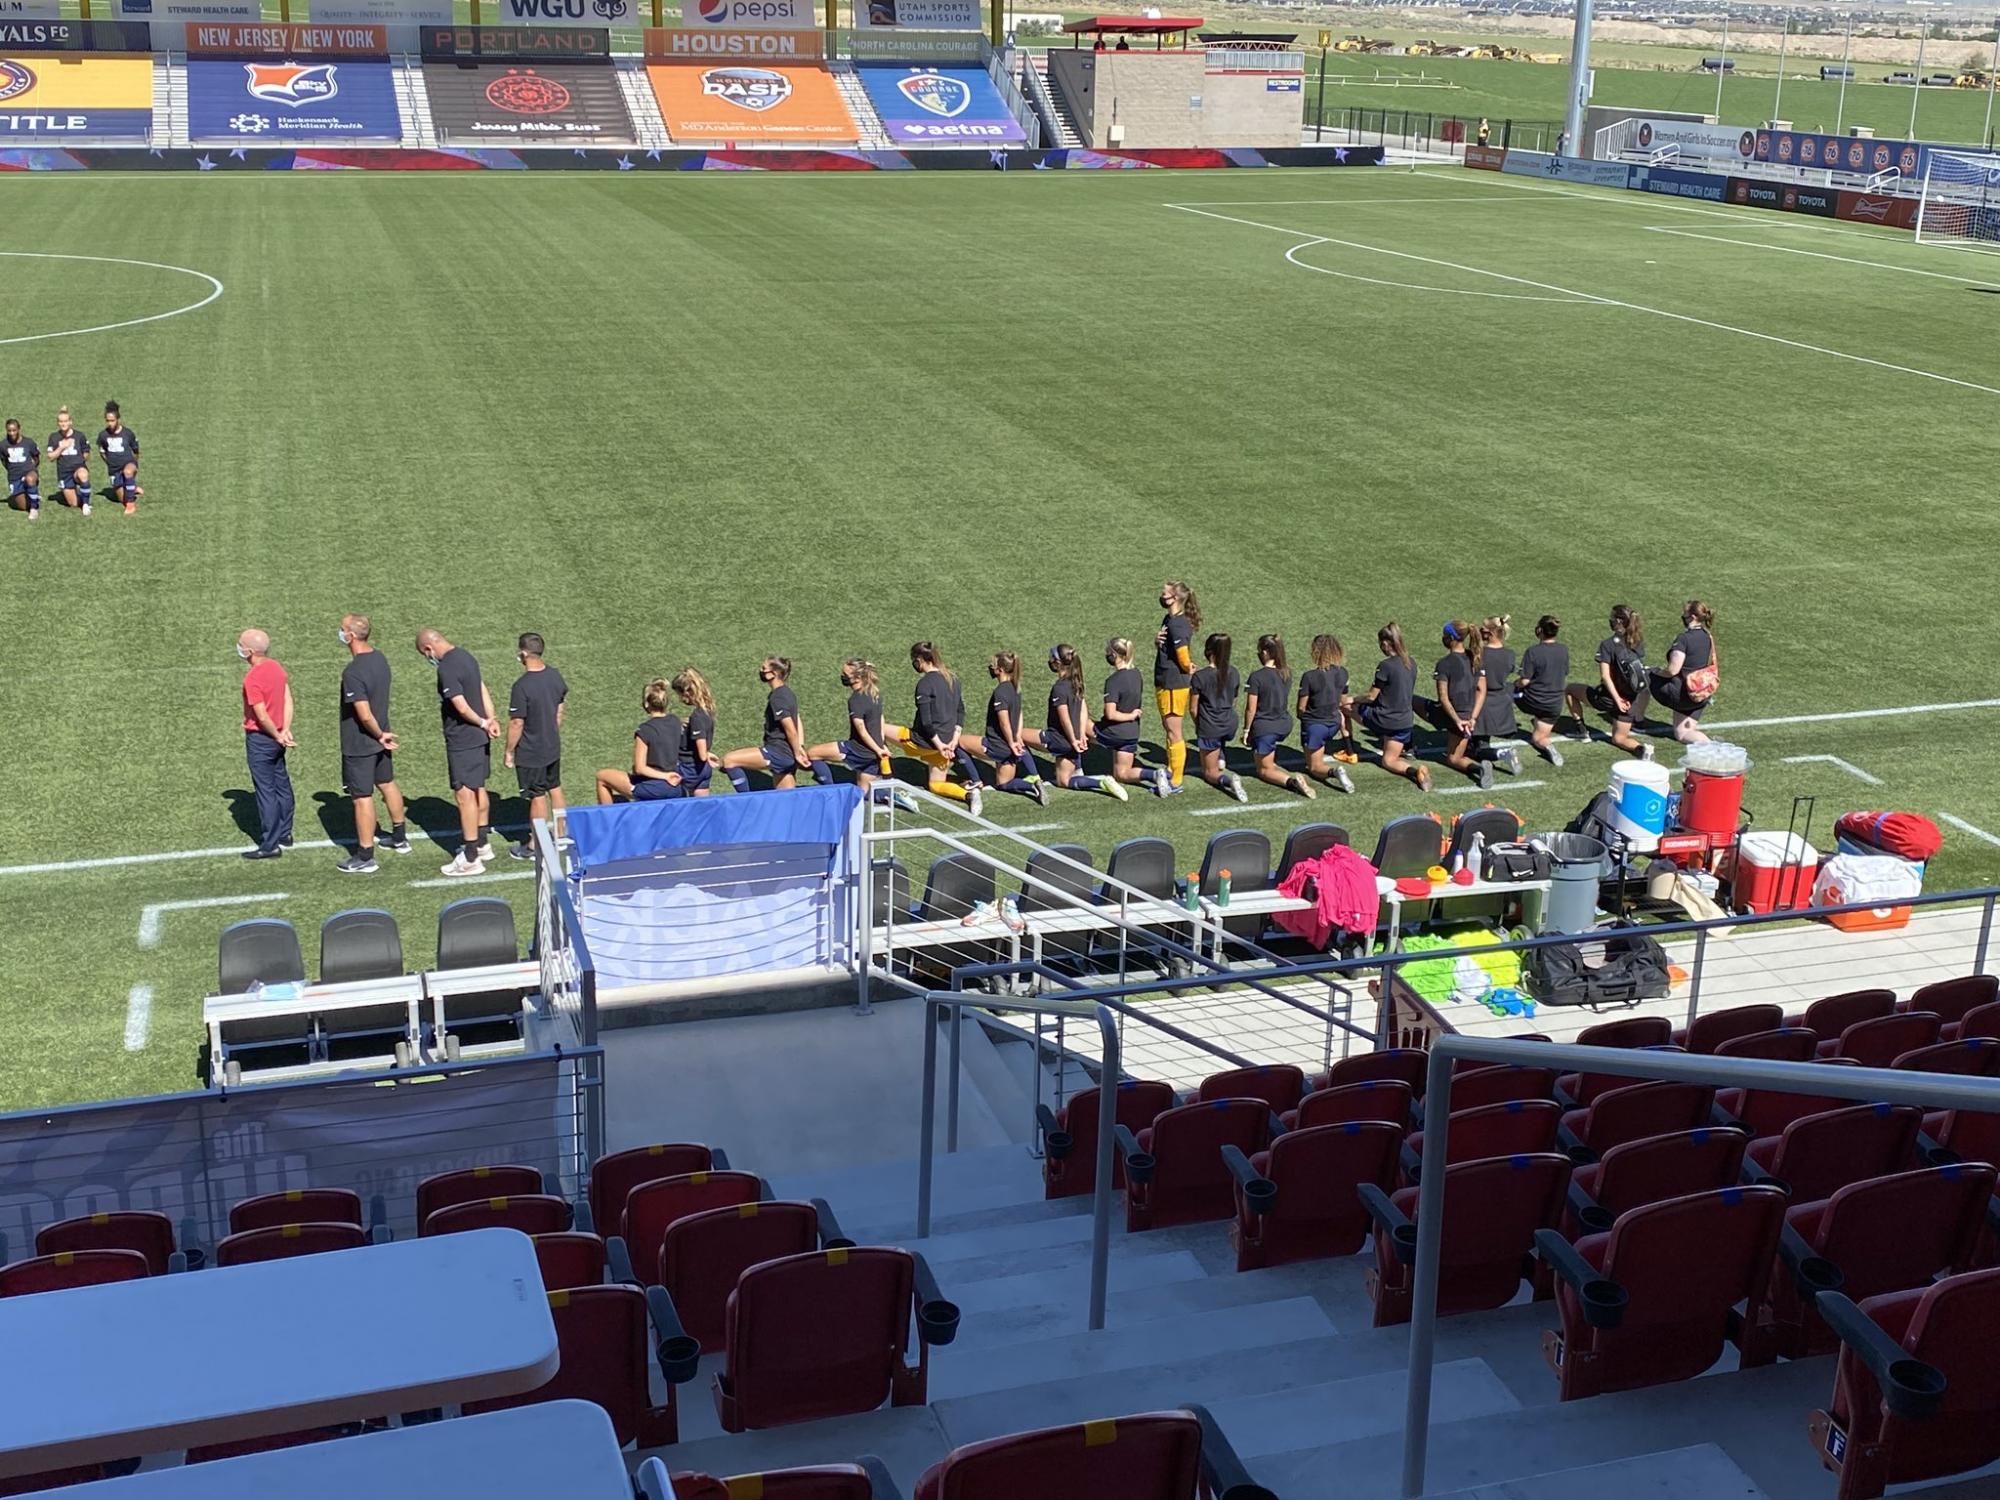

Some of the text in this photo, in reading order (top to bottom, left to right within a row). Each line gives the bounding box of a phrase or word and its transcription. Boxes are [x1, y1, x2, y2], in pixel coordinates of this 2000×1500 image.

[511, 0, 585, 18] WGU
[733, 0, 794, 21] pepsi
[900, 3, 970, 12] UTAH SPORTS
[900, 14, 971, 22] COMMISSION
[50, 26, 69, 38] FC
[199, 28, 230, 46] NEW
[235, 28, 288, 47] JERSEY
[302, 29, 332, 48] NEW
[337, 29, 375, 48] YORK
[435, 32, 596, 50] PORTLAND
[673, 34, 796, 53] HOUSTON
[853, 41, 978, 51] NORTH CAROLINA COURAGE
[703, 84, 792, 96] DASH
[928, 124, 1003, 136] aetna
[1649, 180, 1721, 198] STEWARD HEALTH CARE
[1750, 189, 1776, 200] TOYOTA
[1798, 194, 1826, 208] TOYOTA
